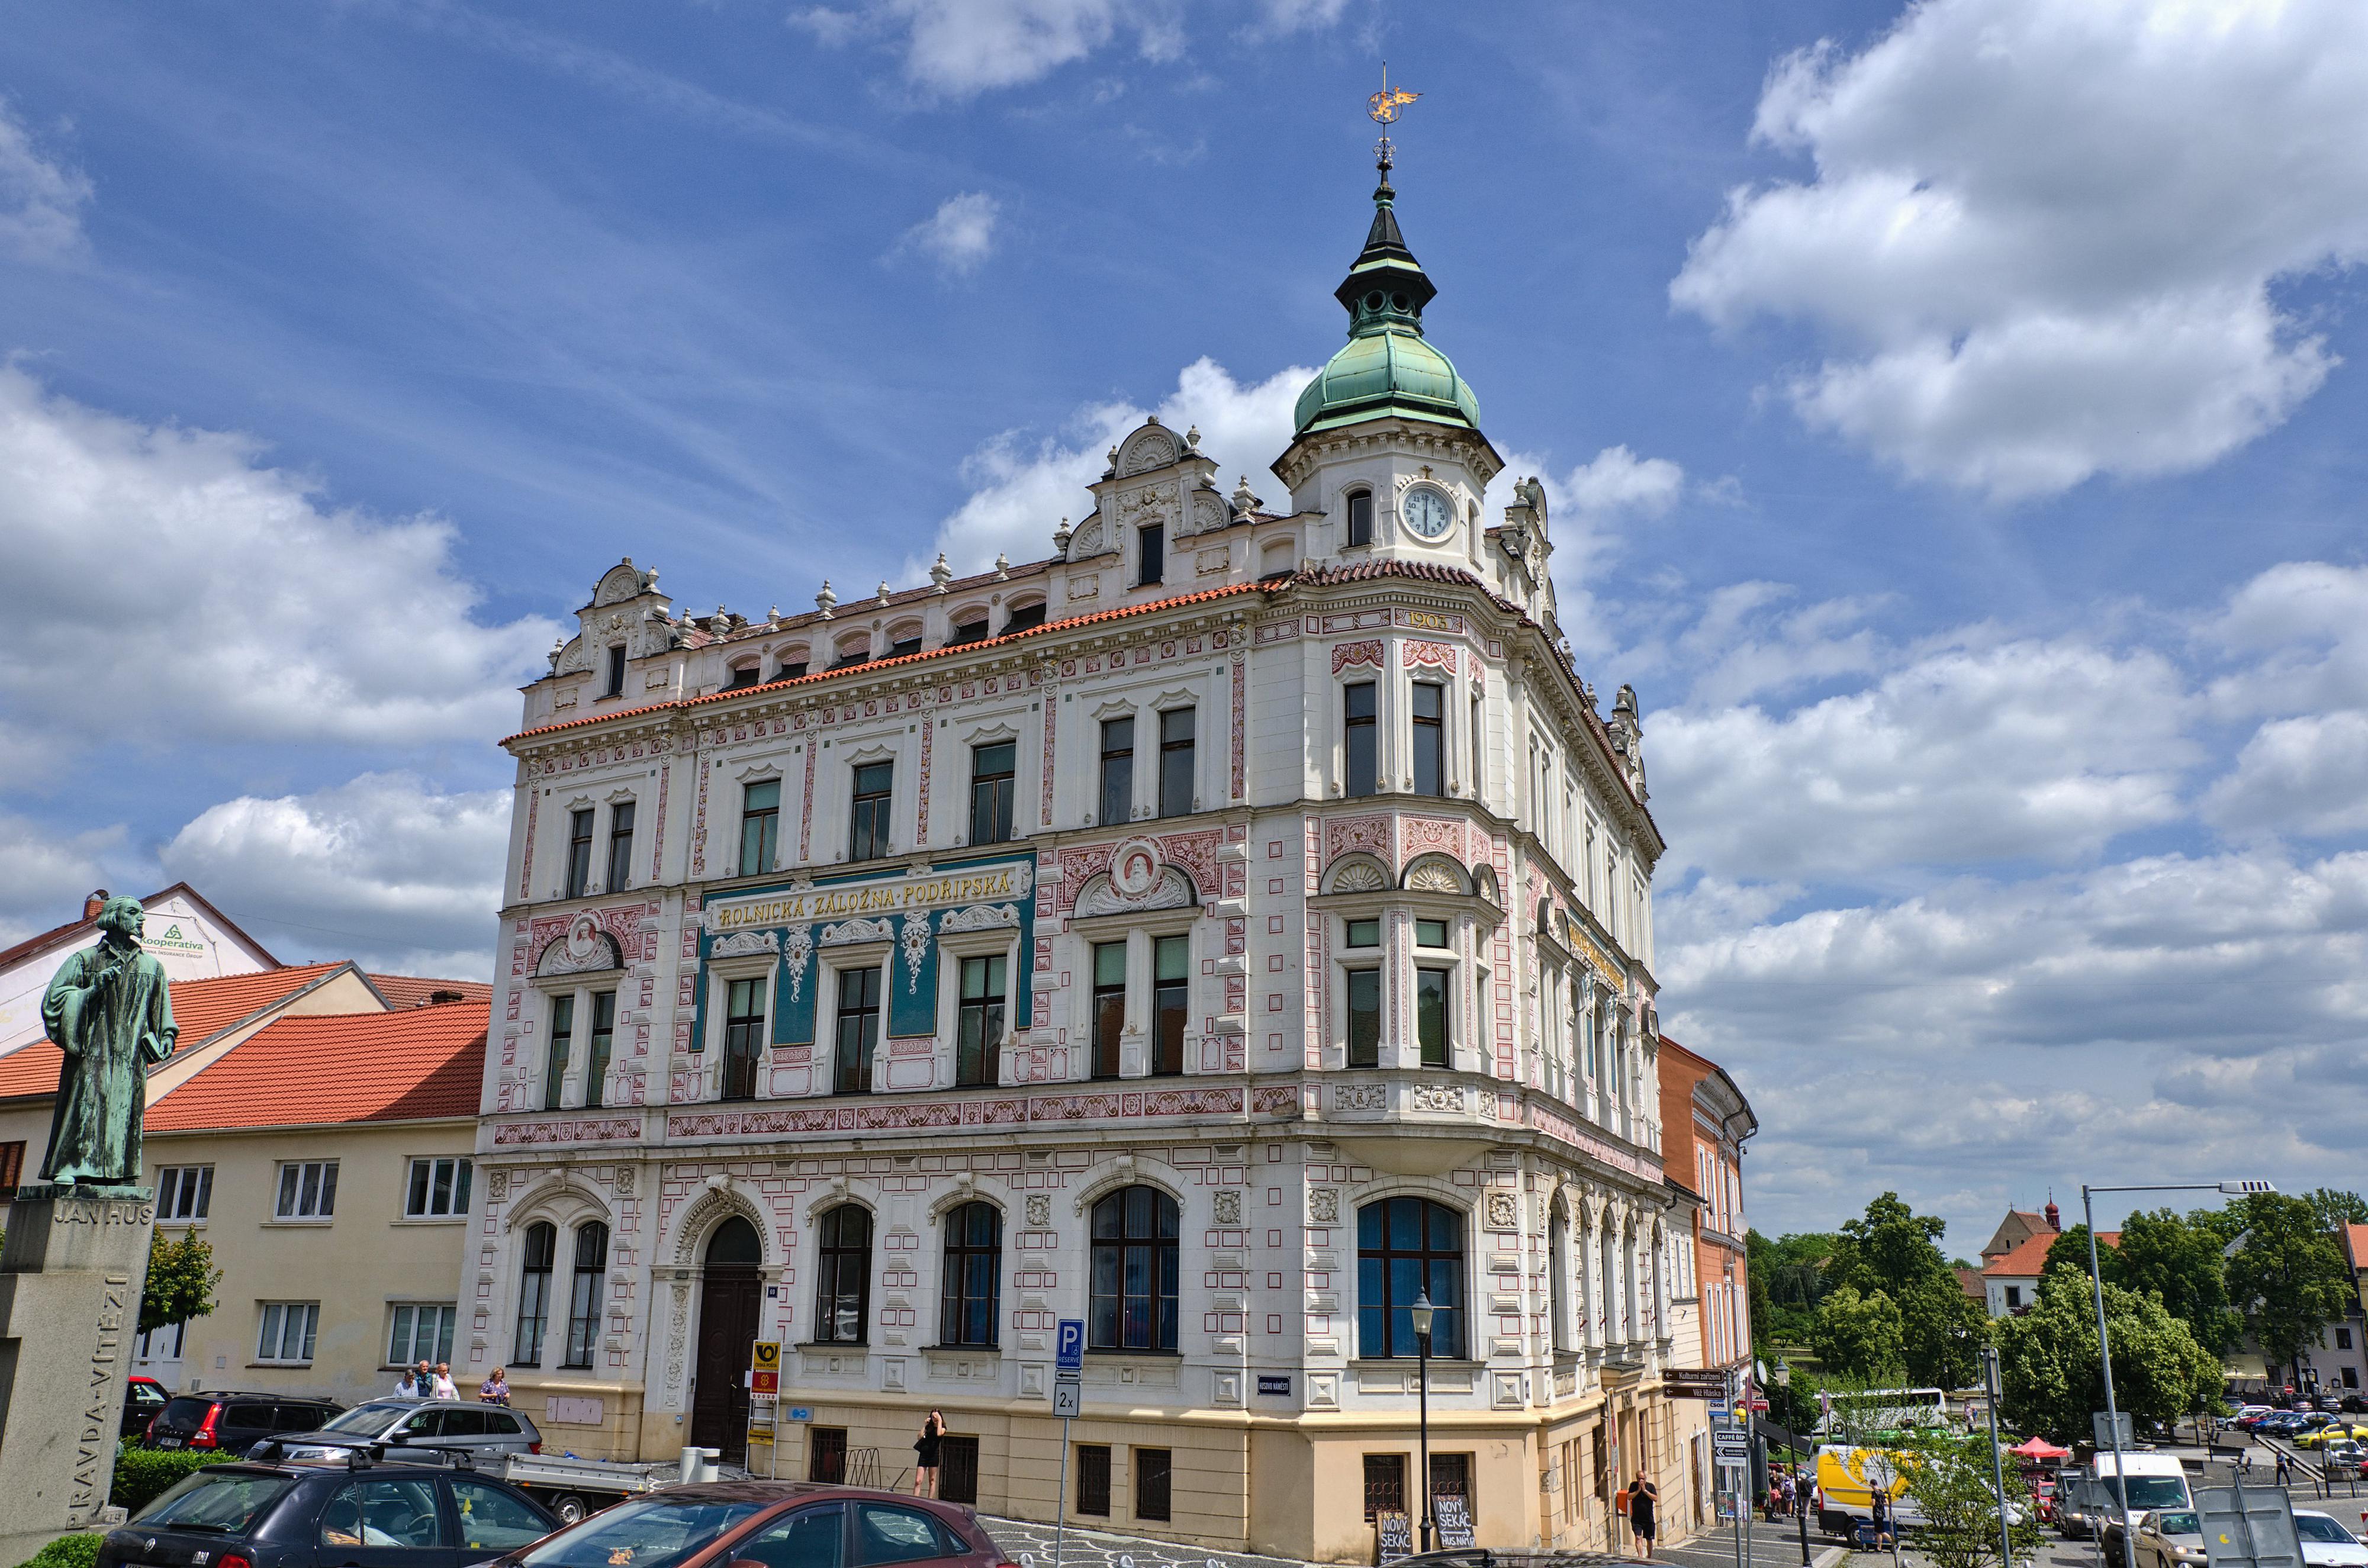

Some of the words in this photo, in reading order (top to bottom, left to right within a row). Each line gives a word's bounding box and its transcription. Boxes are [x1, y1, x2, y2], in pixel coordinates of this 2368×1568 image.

[1410, 611, 1447, 629] 1903
[721, 896, 805, 925] ROLNICKÁ
[815, 888, 895, 915] ZÁLOŽNA
[903, 871, 1010, 904] PODŘIPSKÁ
[140, 937, 204, 949] Kooperativa
[54, 1203, 102, 1224] JAN
[105, 1204, 153, 1225] HUS
[1063, 1326, 1078, 1353] P
[1679, 1371, 1699, 1380] Kulturní
[1273, 1381, 1289, 1390] NÁMĚSTÍ
[1703, 1389, 1721, 1397] Hláska
[1439, 1499, 1462, 1513] NOVÝ
[1383, 1516, 1407, 1532] NOVÝ
[1439, 1511, 1472, 1527] SEKÁČ
[1381, 1530, 1411, 1548] SEKÁČ
